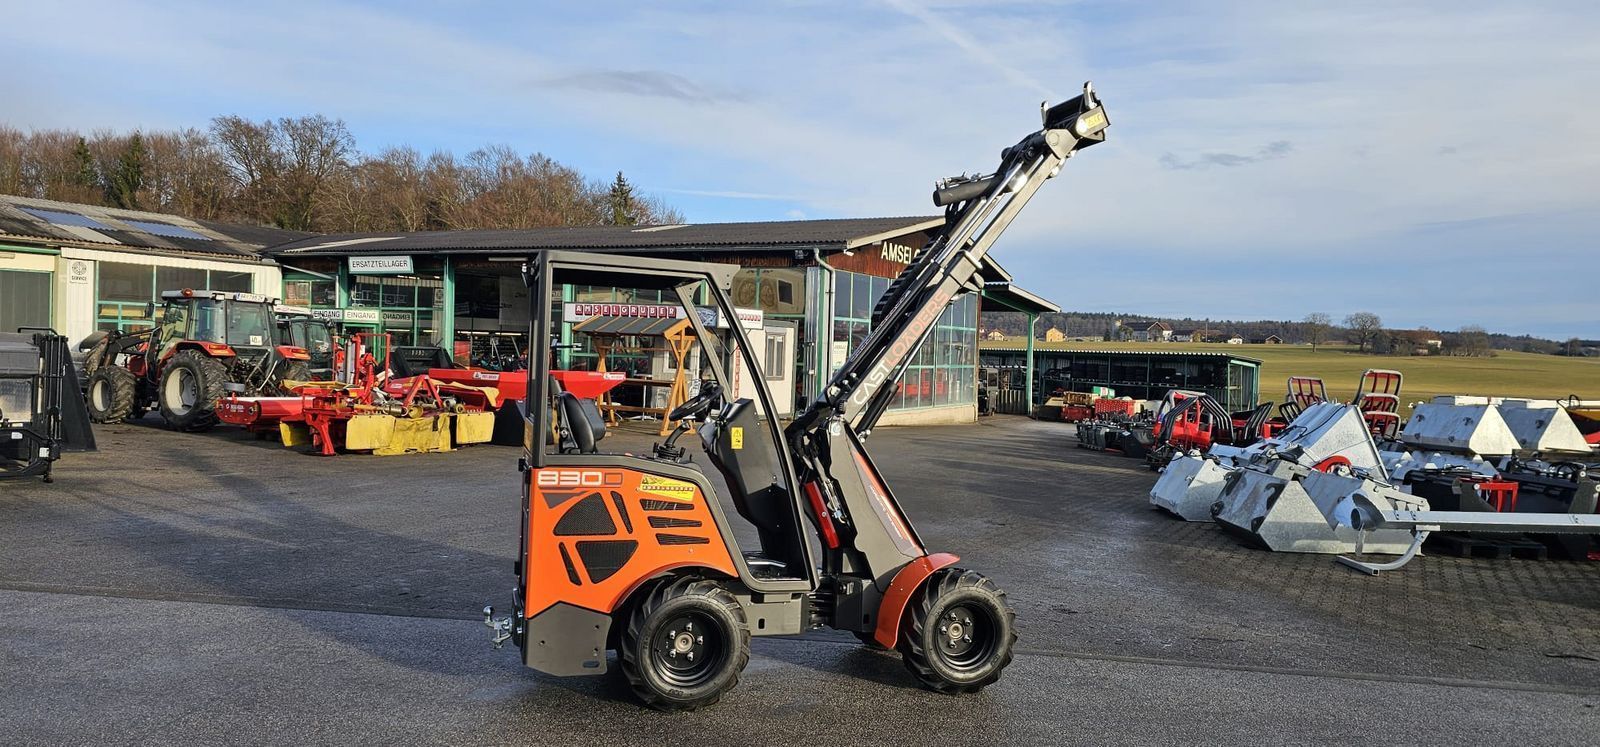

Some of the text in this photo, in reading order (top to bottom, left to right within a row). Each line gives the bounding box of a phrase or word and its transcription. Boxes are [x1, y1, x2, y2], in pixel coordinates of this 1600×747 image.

[352, 260, 408, 268] ERSATZTEILLAGER
[313, 310, 341, 319] EINGANG
[575, 304, 677, 317] AMSELGRUBER
[346, 311, 376, 320] EINGANG
